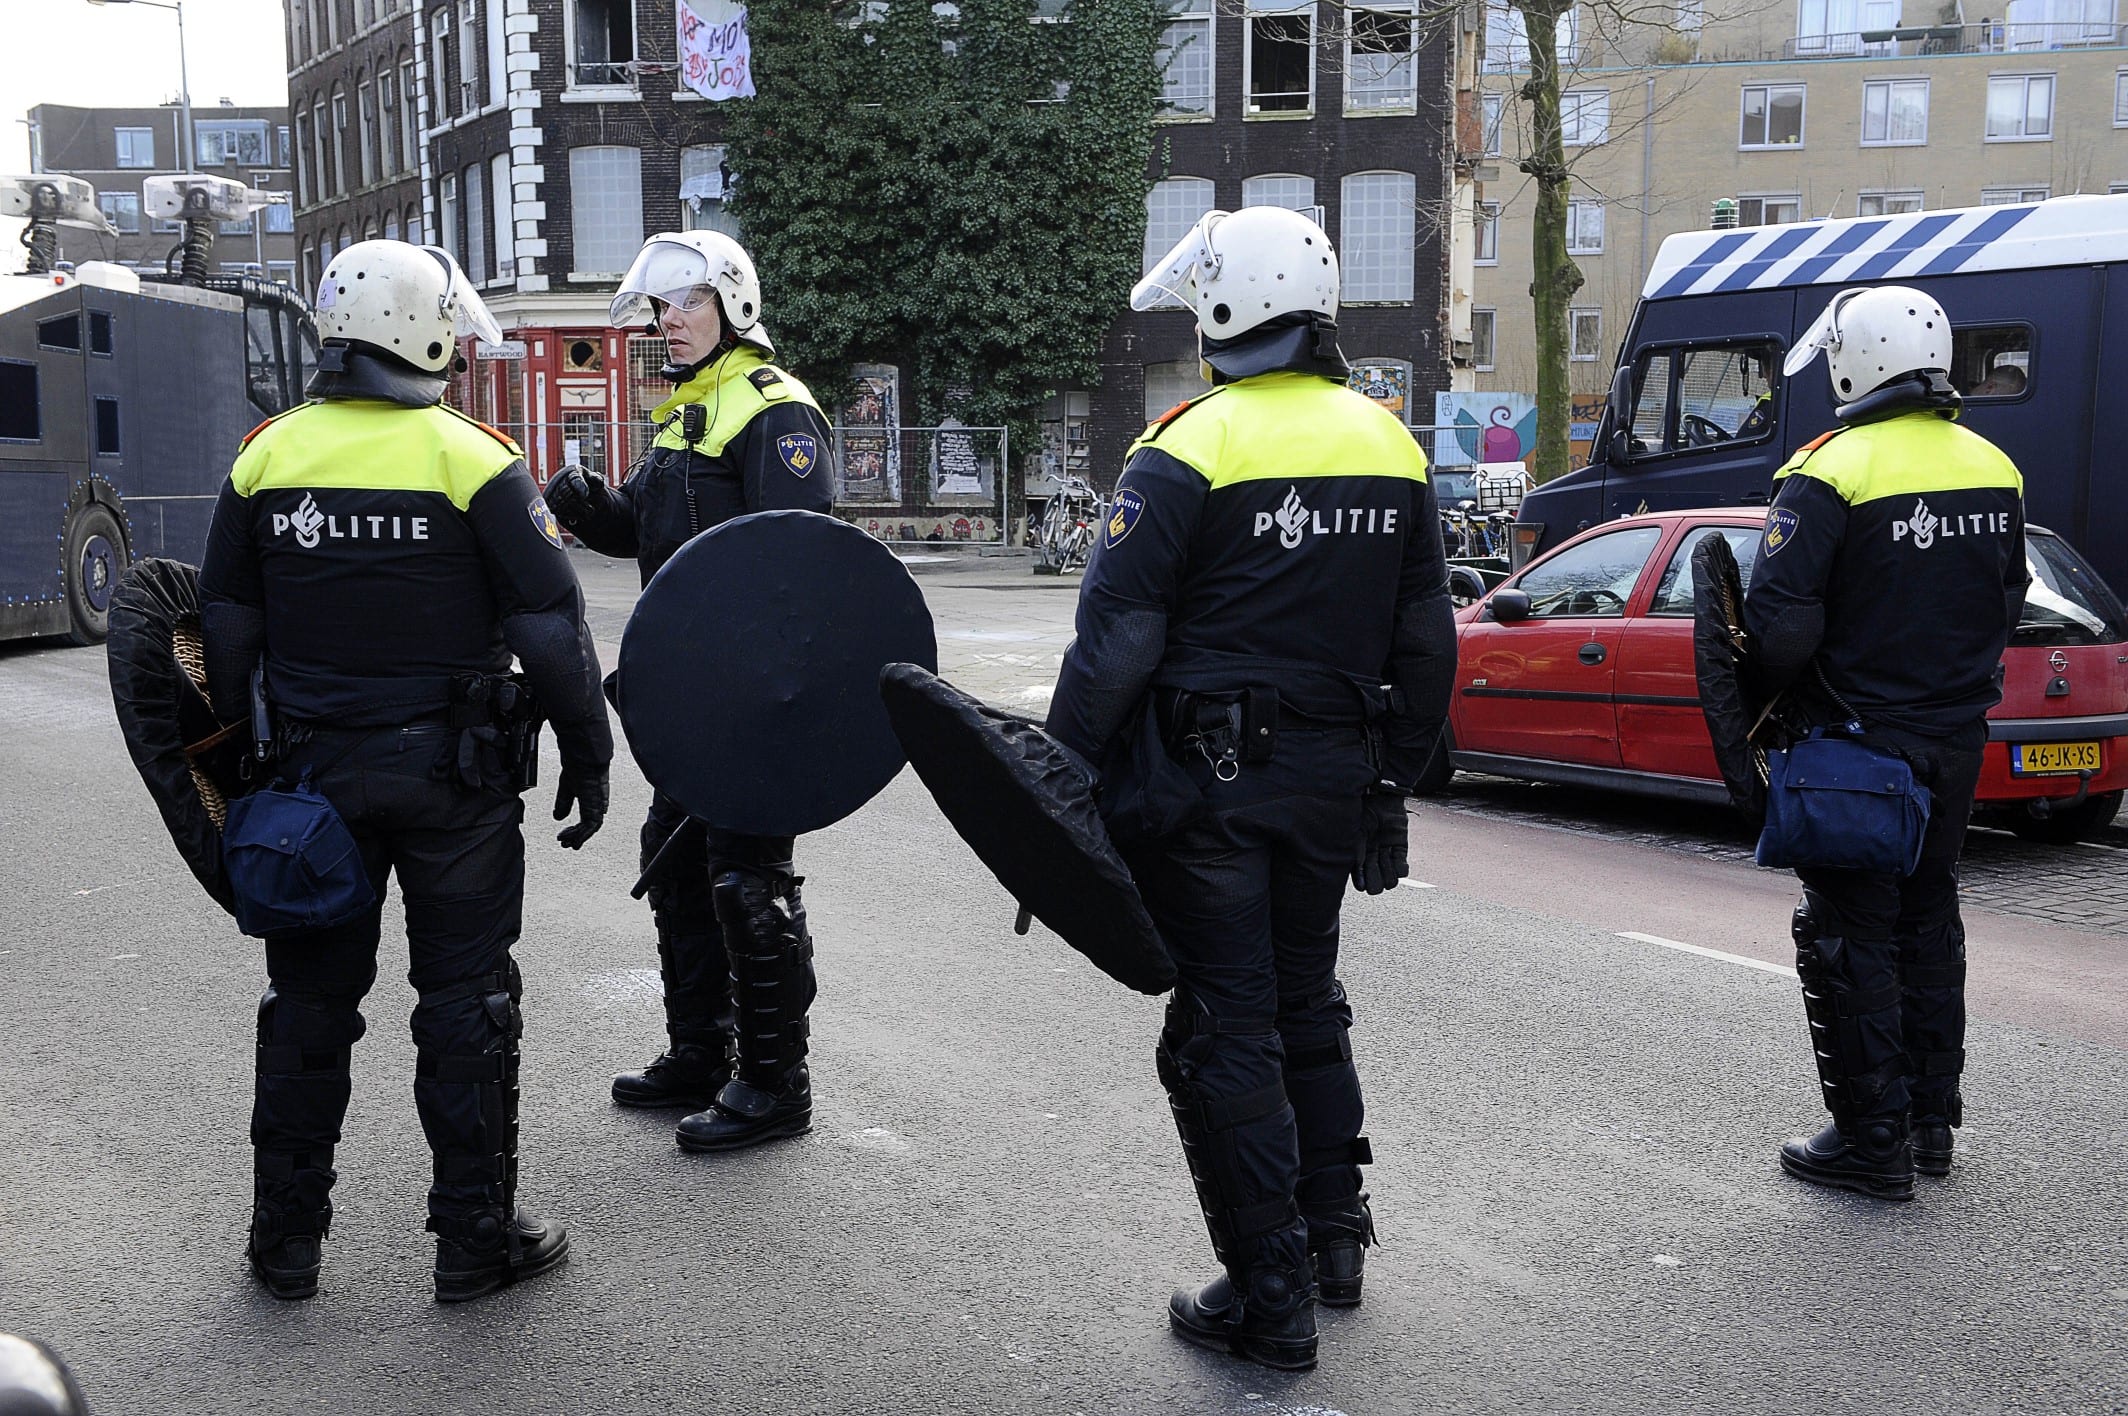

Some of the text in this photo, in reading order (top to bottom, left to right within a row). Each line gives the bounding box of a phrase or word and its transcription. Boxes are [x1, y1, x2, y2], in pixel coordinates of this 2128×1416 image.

[781, 438, 813, 448] POLITIE
[272, 502, 429, 548] POLITIE
[1254, 498, 1398, 549] POLITIE
[1892, 505, 2008, 549] POLITIE
[2028, 746, 2095, 767] 46-JK-XS
